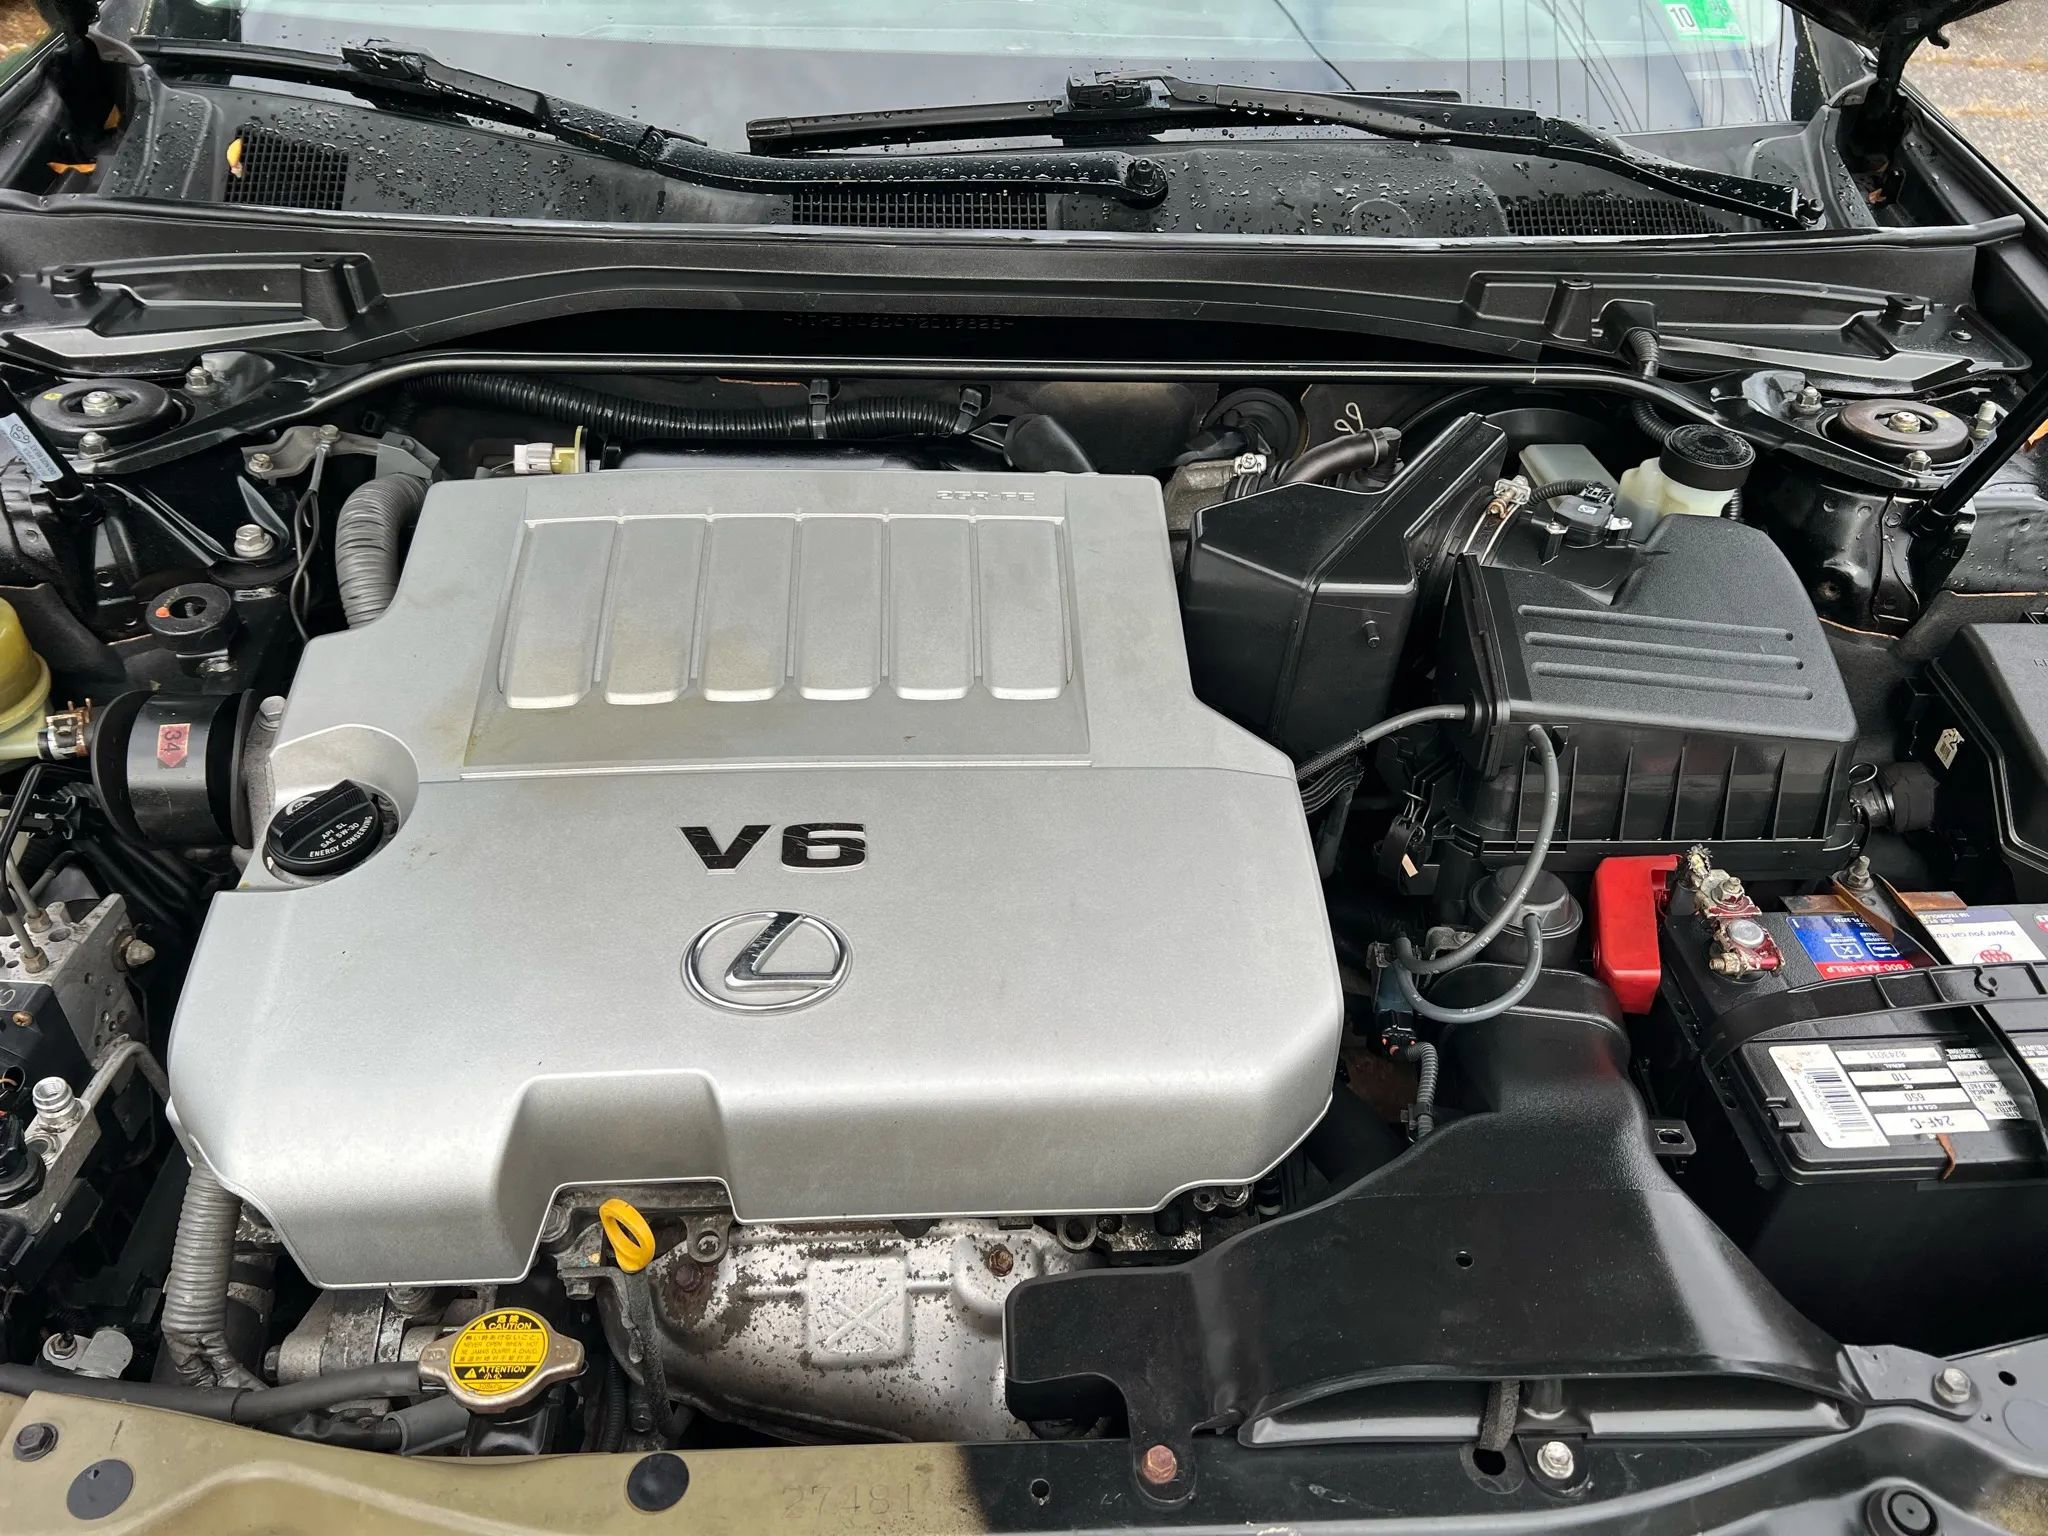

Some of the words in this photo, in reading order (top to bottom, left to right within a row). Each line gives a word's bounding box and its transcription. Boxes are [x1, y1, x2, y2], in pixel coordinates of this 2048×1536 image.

[1670, 7, 1695, 28] 10
[936, 490, 1035, 502] 2GR-FE
[164, 730, 182, 752] 34
[309, 845, 340, 858] ENERGY
[341, 815, 373, 848] CONSERVING
[320, 837, 336, 848] SAE
[335, 822, 360, 839] 5W-30
[321, 829, 335, 840] API
[335, 822, 348, 830] SL
[677, 823, 867, 873] V6
[1891, 1072, 1912, 1081] 110
[488, 1322, 532, 1330] CAUTION
